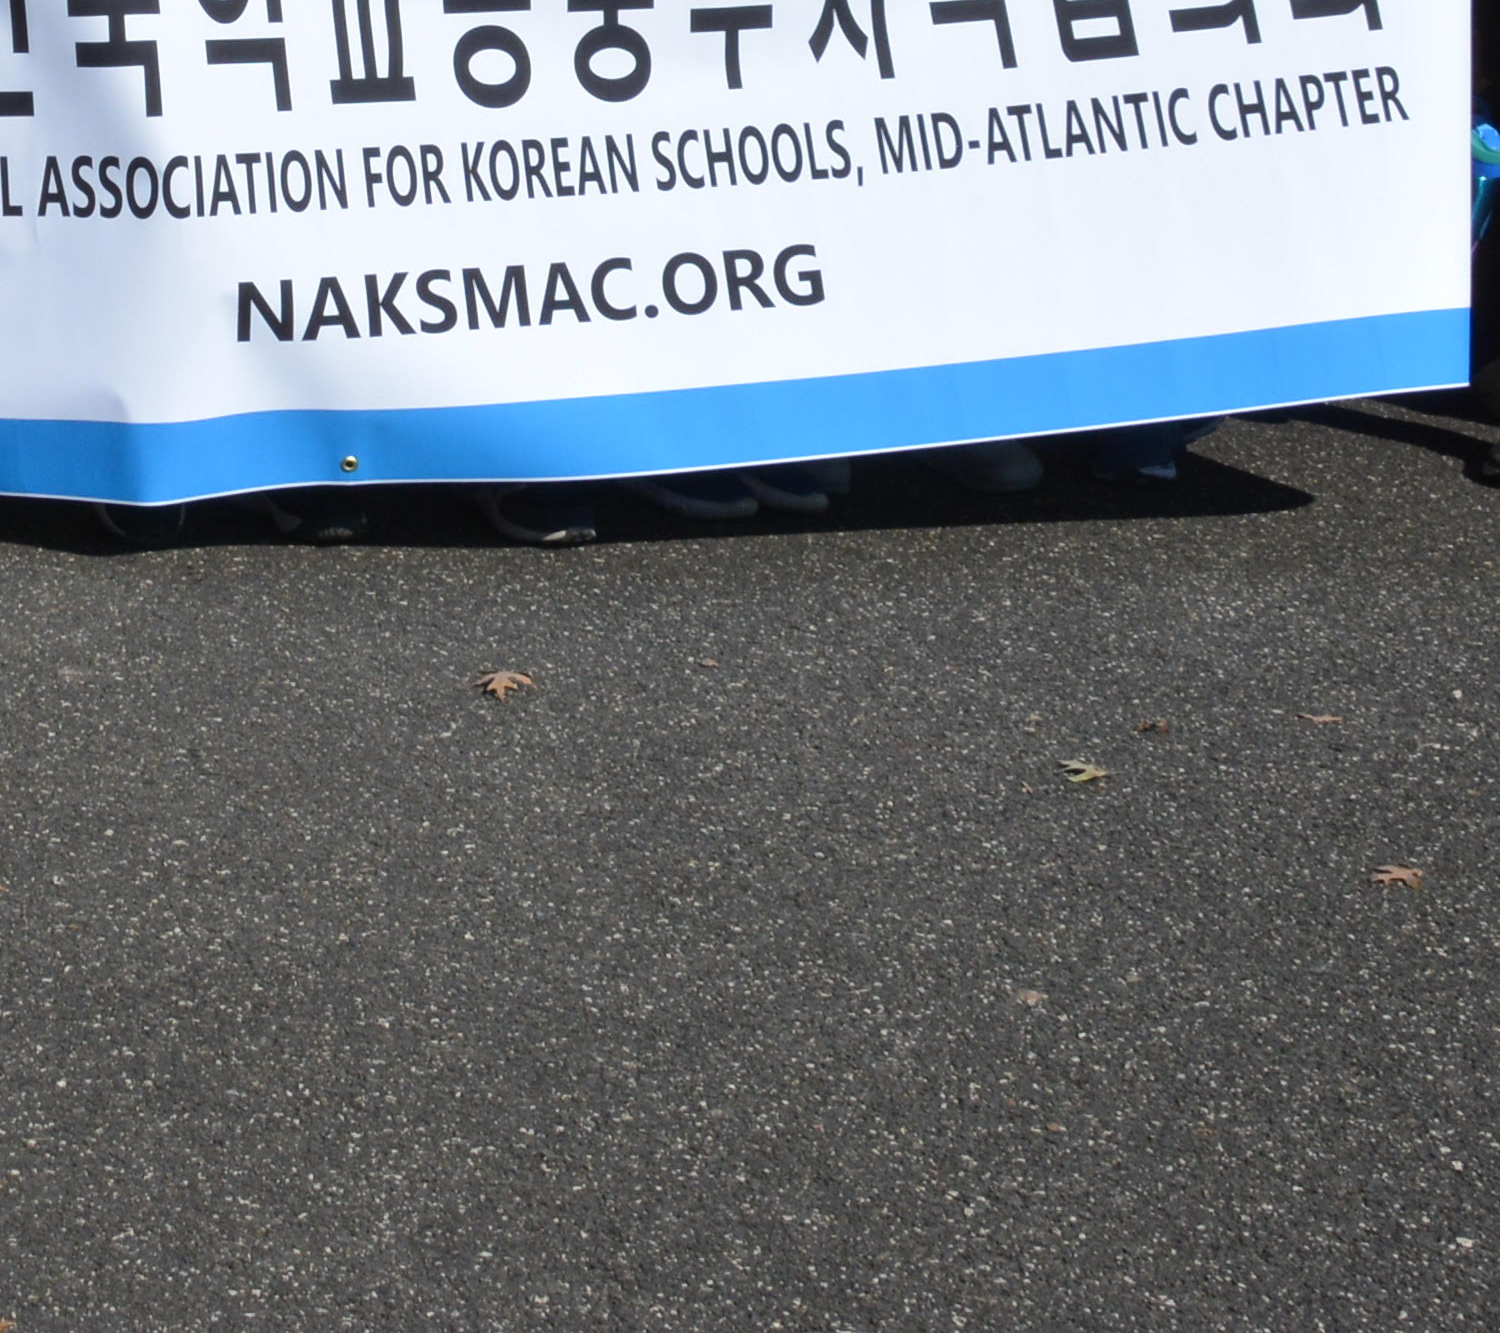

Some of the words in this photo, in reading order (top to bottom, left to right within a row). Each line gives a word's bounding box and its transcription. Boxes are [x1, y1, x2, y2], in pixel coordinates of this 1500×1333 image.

[37, 148, 350, 219] ASSOCIATION
[364, 144, 452, 209] FOR
[461, 134, 639, 203] KOREAN
[651, 119, 865, 187] SCHOOLS,
[875, 87, 1199, 175] MID-ATLANTIC
[1207, 64, 1410, 141] CHAPTER
[237, 244, 826, 344] NAKSMAC.ORG
